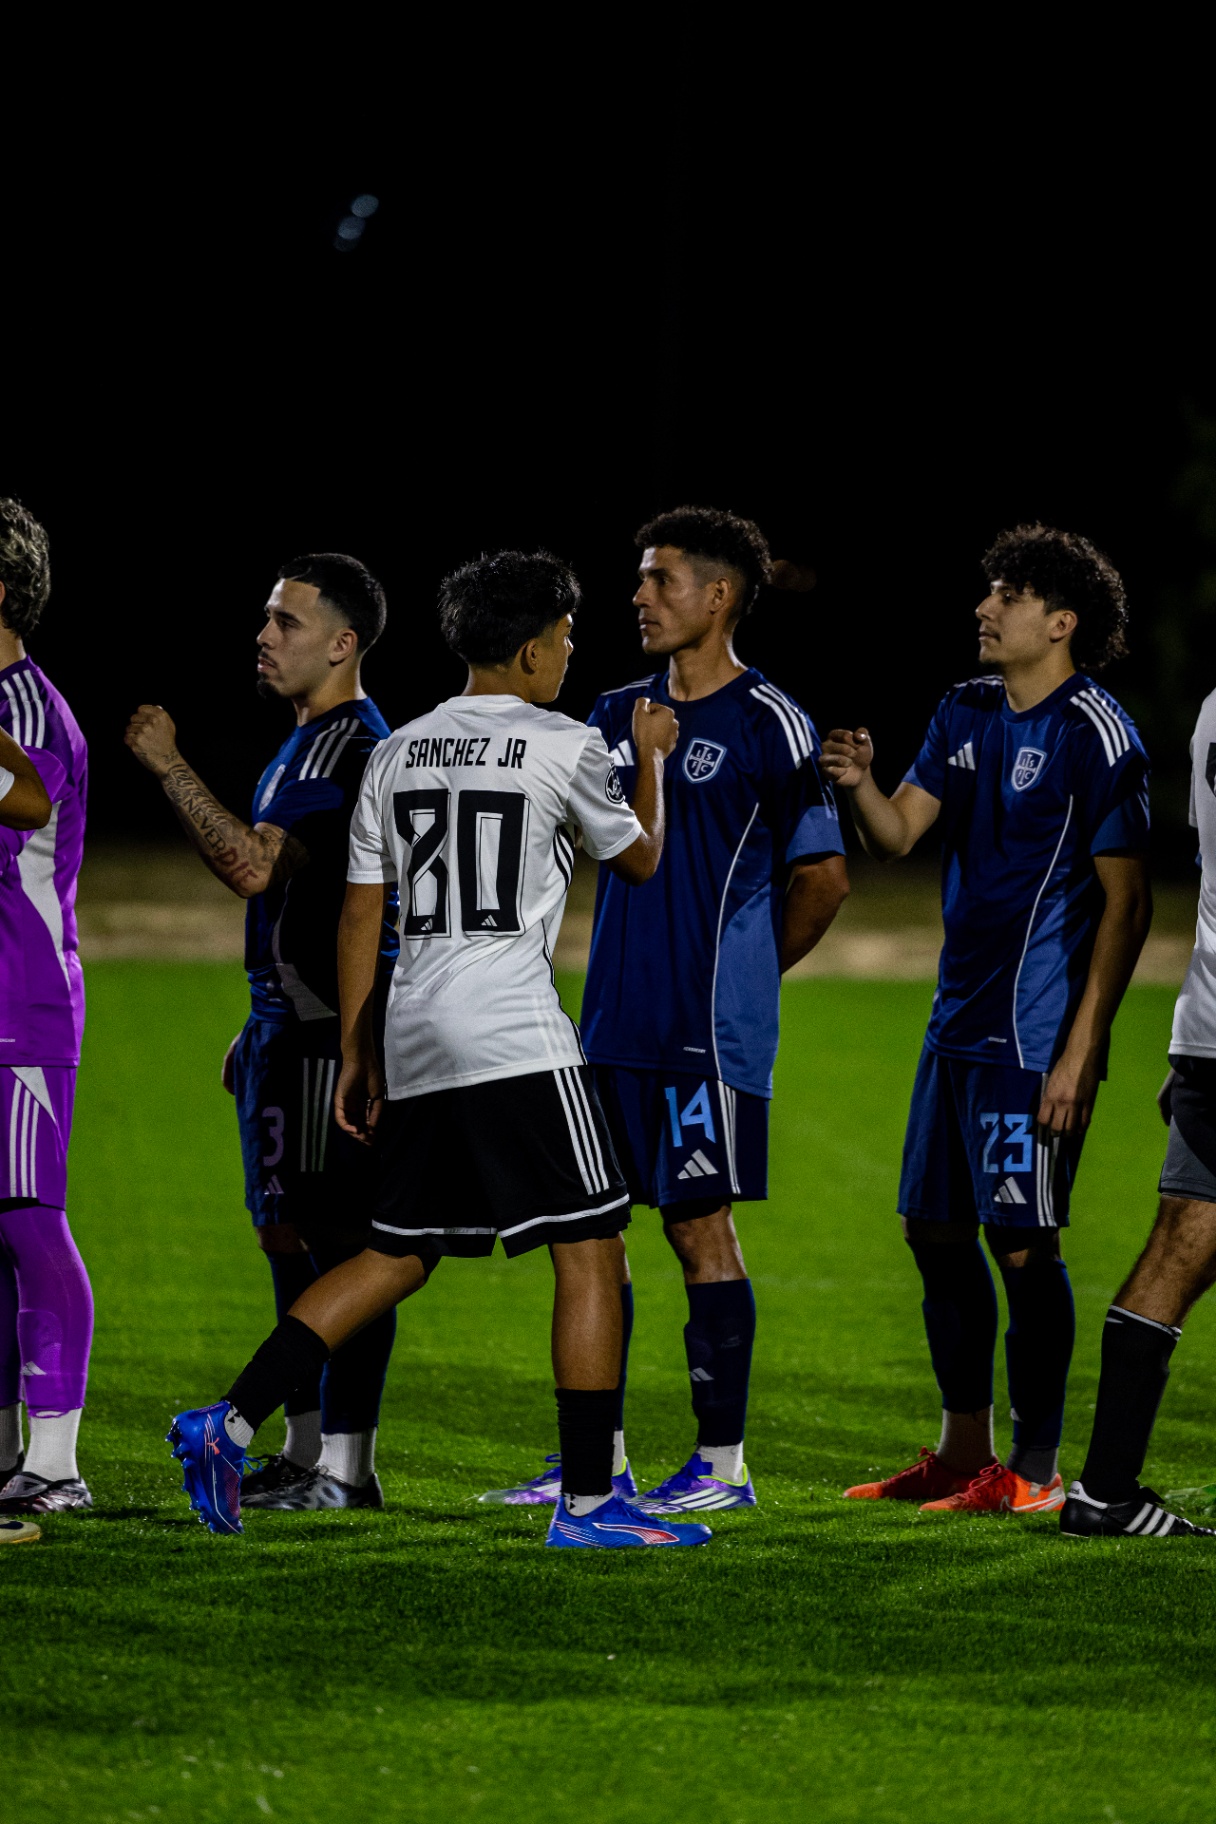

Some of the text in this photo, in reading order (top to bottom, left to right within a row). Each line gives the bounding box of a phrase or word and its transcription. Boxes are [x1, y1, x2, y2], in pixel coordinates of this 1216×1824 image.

[406, 737, 527, 769] SANCHEZ JR
[182, 795, 226, 853] NEVER
[393, 788, 530, 938] 80
[262, 1106, 285, 1167] 3
[664, 1080, 717, 1148] 14
[979, 1112, 1033, 1174] 23
